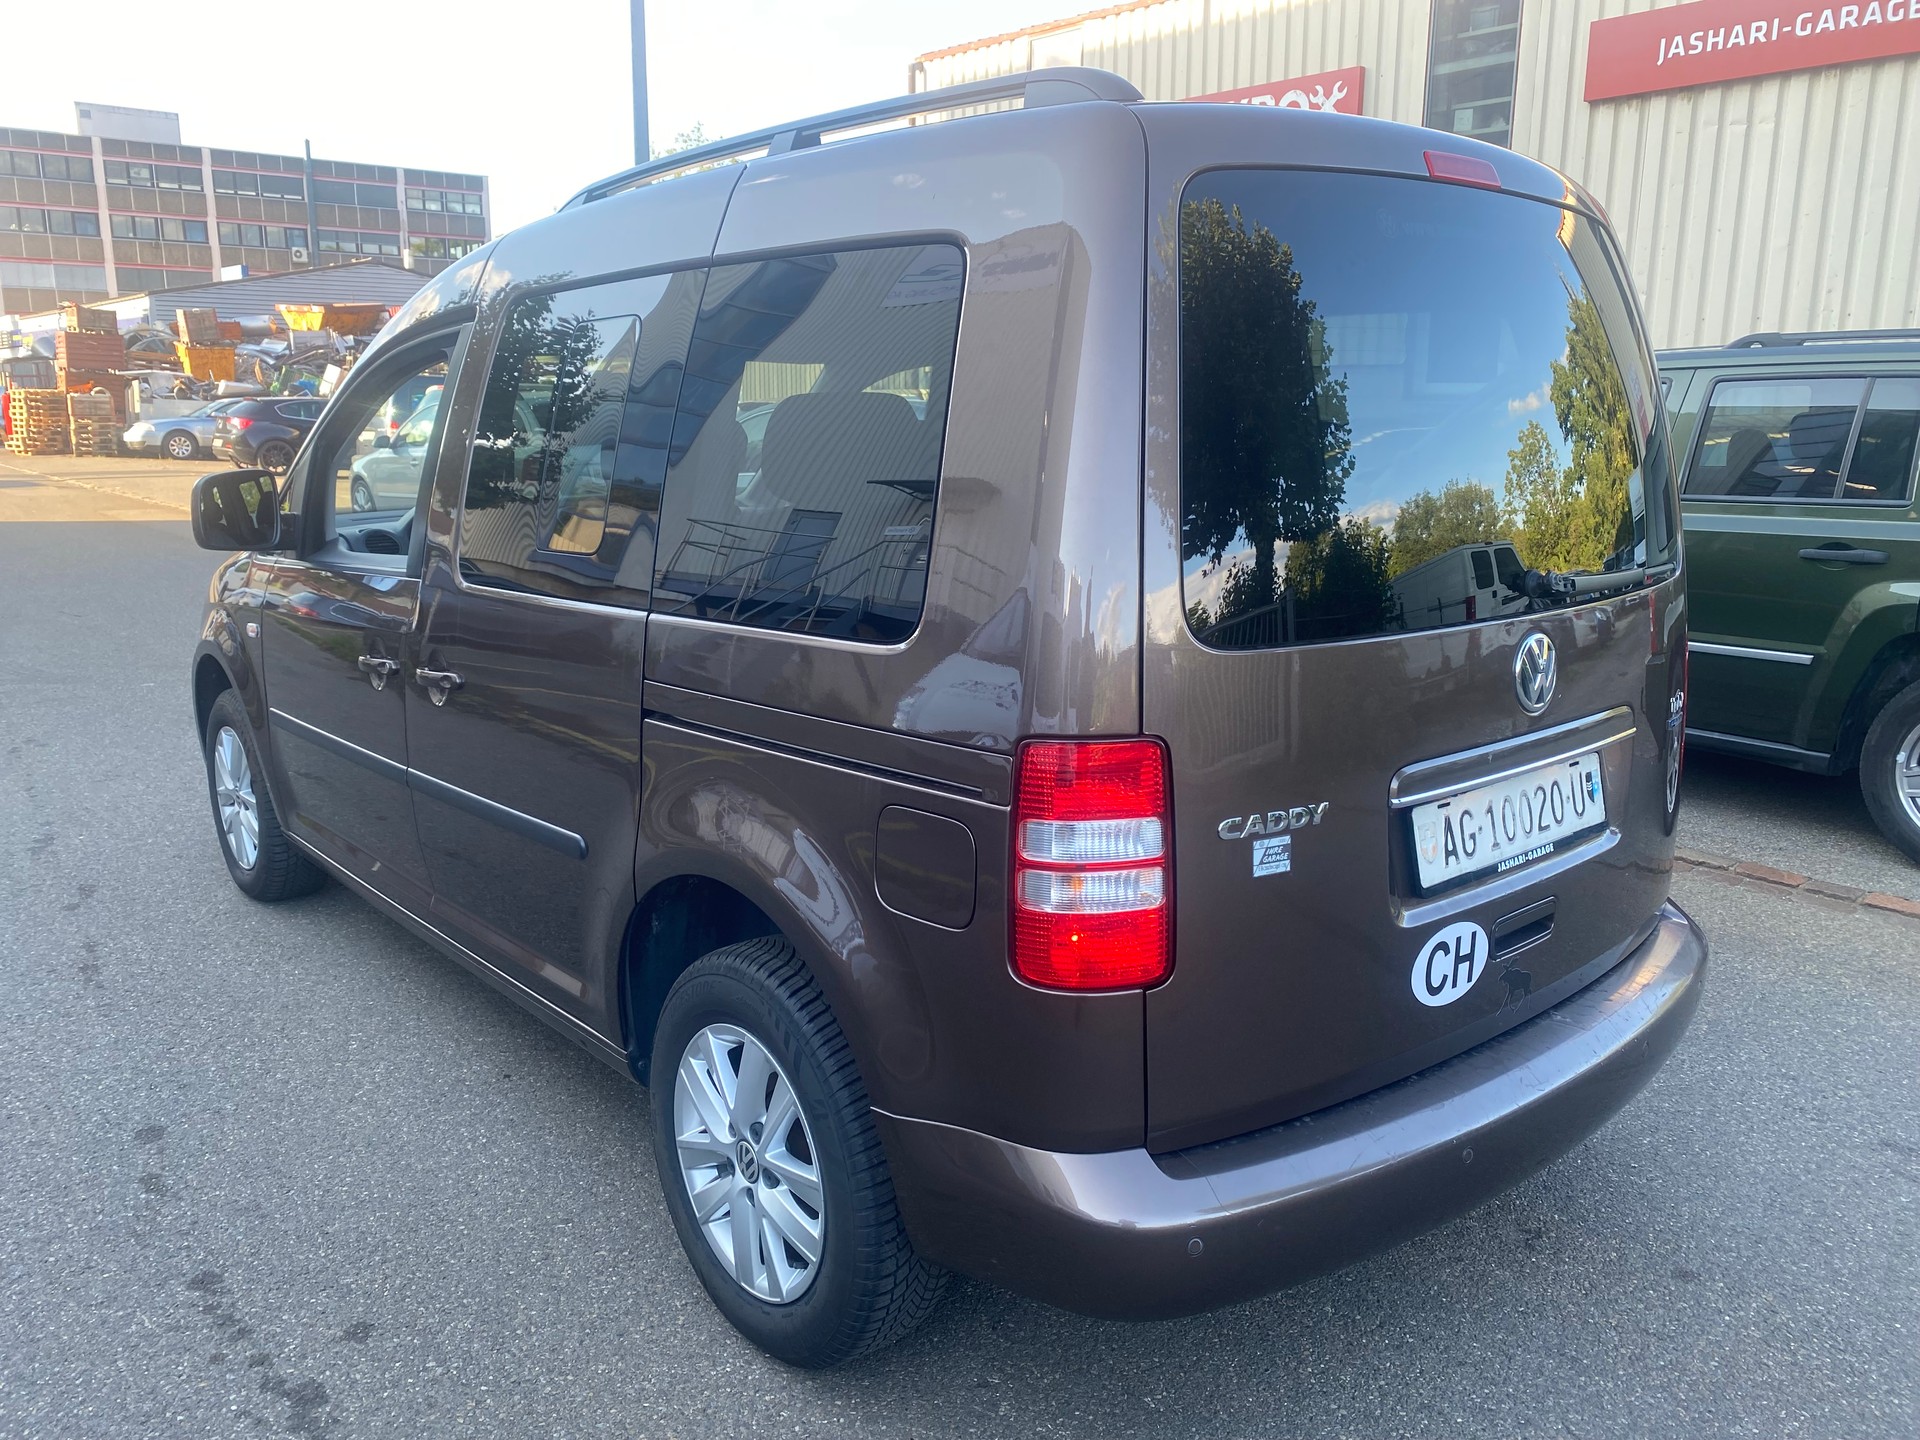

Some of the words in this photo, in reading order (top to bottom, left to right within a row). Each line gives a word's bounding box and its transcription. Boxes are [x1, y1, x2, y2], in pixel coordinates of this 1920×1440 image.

[1217, 801, 1329, 840] CADDY
[1262, 852, 1289, 863] GARAGE
[1497, 842, 1554, 873] JASHARI-GARAGE
[1425, 930, 1477, 997] CH
